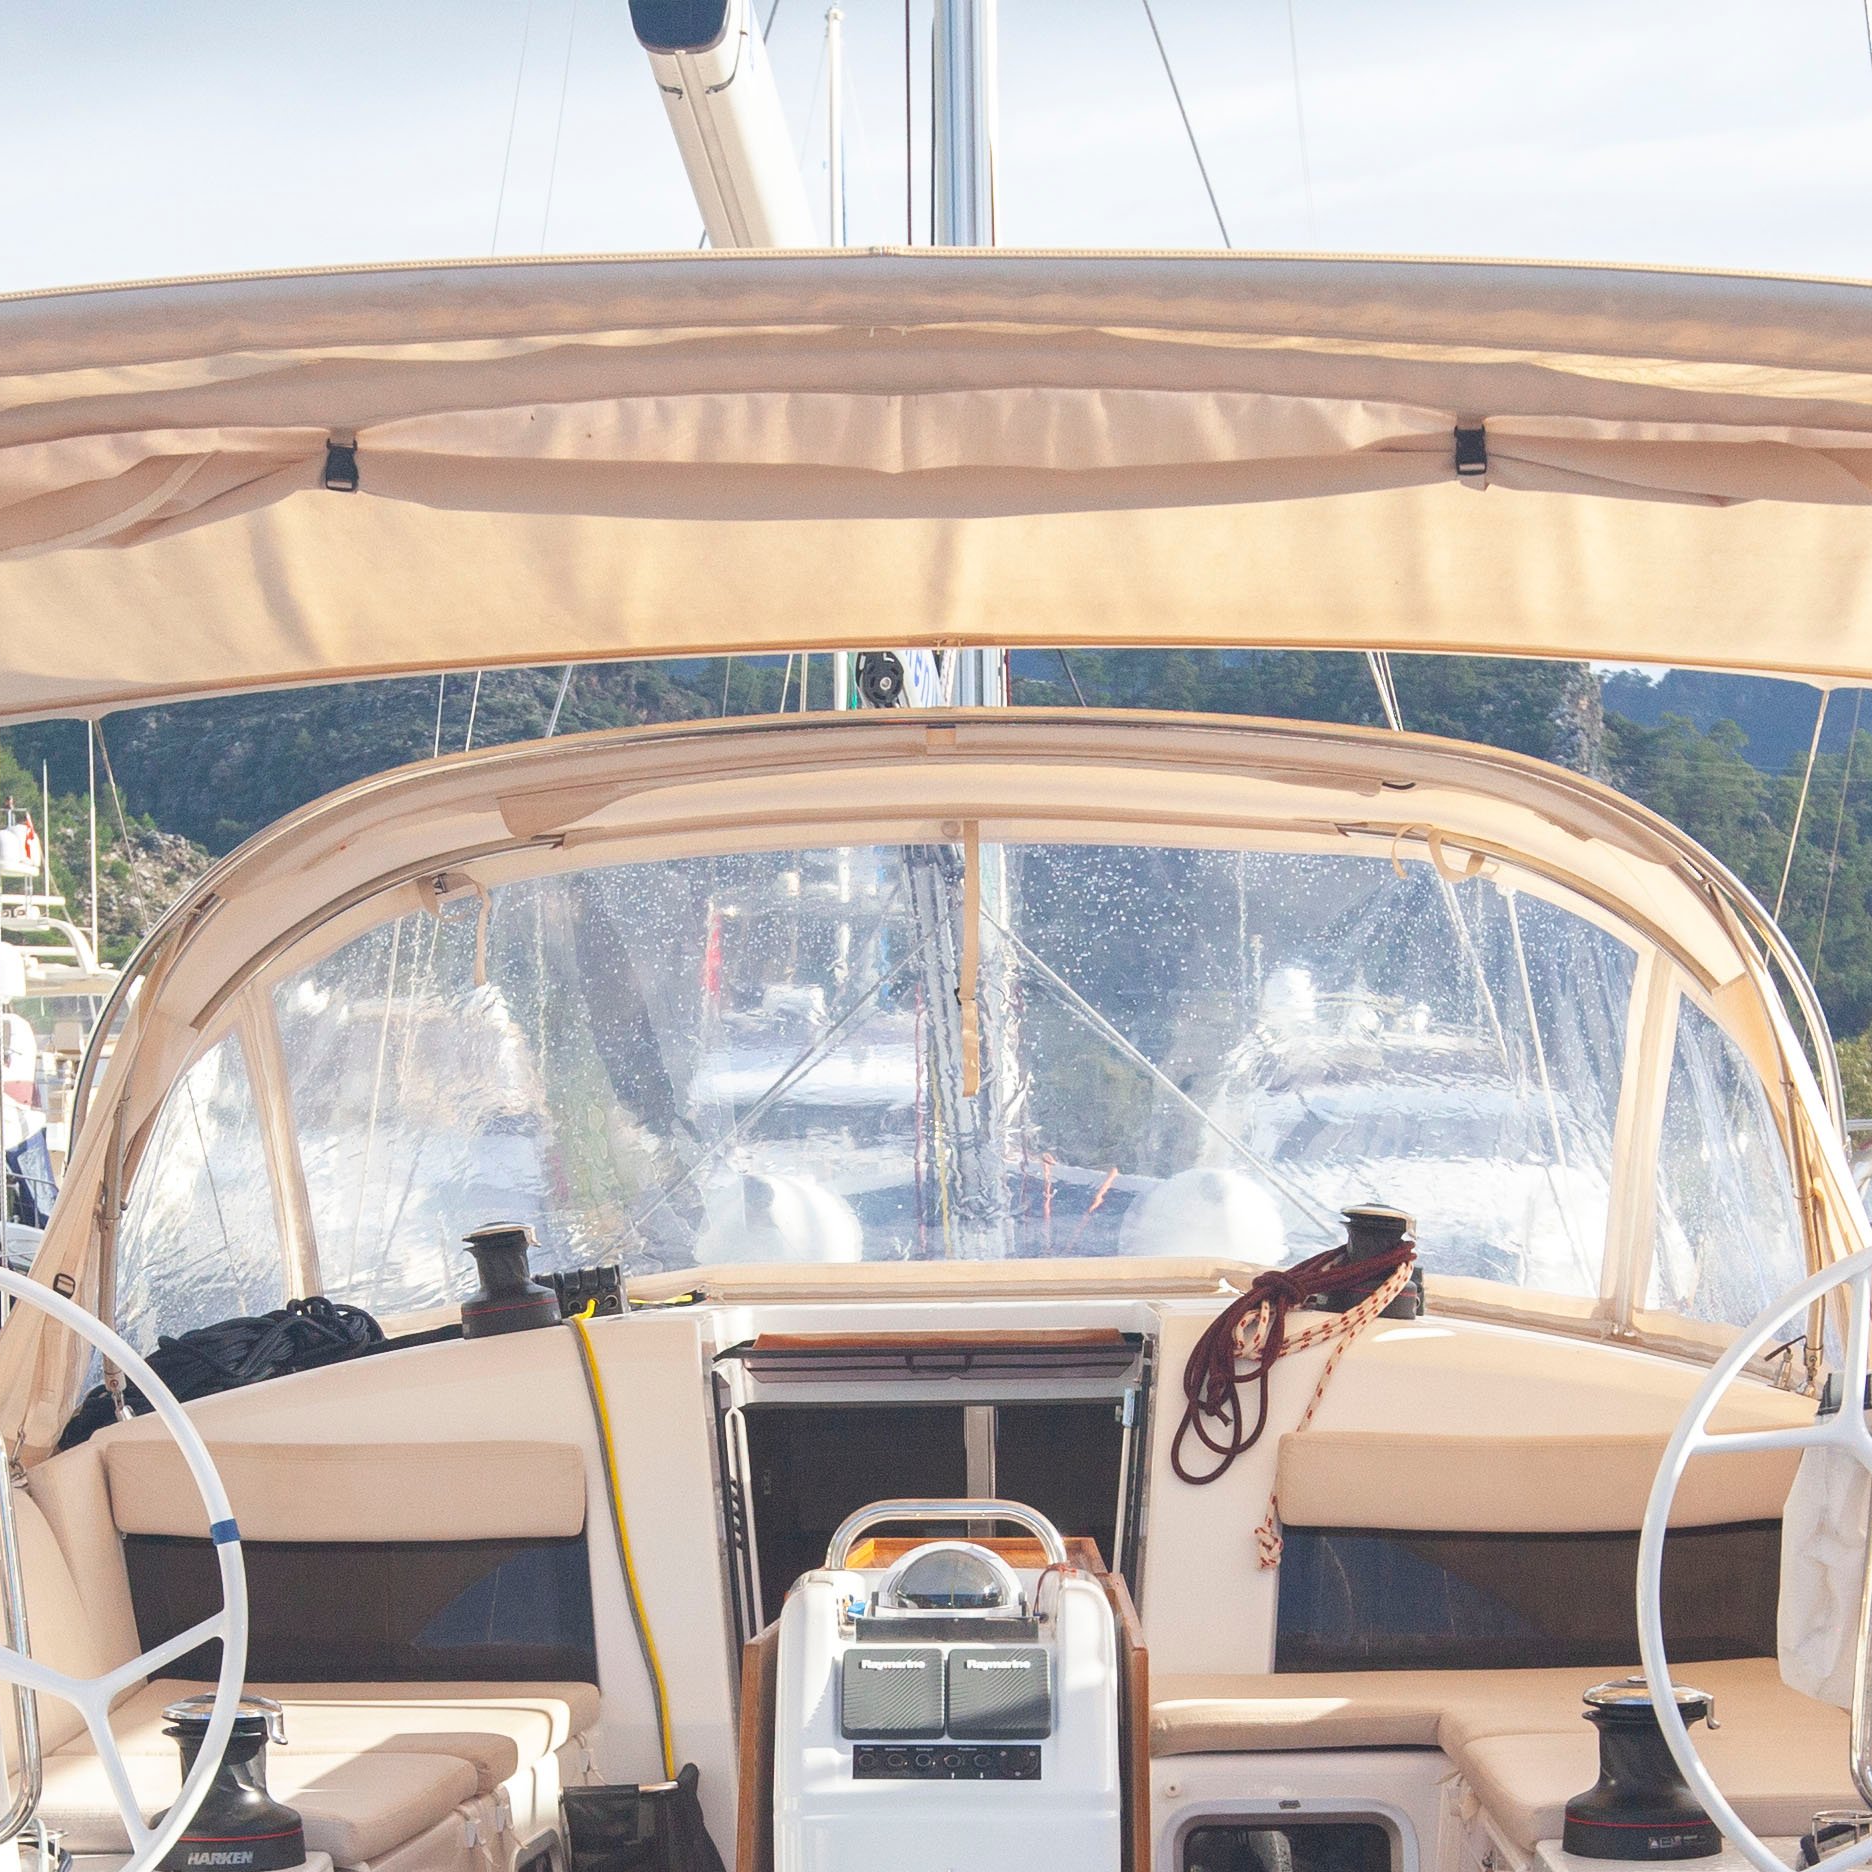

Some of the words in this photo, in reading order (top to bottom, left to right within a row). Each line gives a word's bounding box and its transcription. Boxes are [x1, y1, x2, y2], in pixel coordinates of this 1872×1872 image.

[861, 1659, 926, 1670] Raymarine
[965, 1659, 1031, 1670] Raymarine
[187, 1850, 255, 1866] HARKEN
